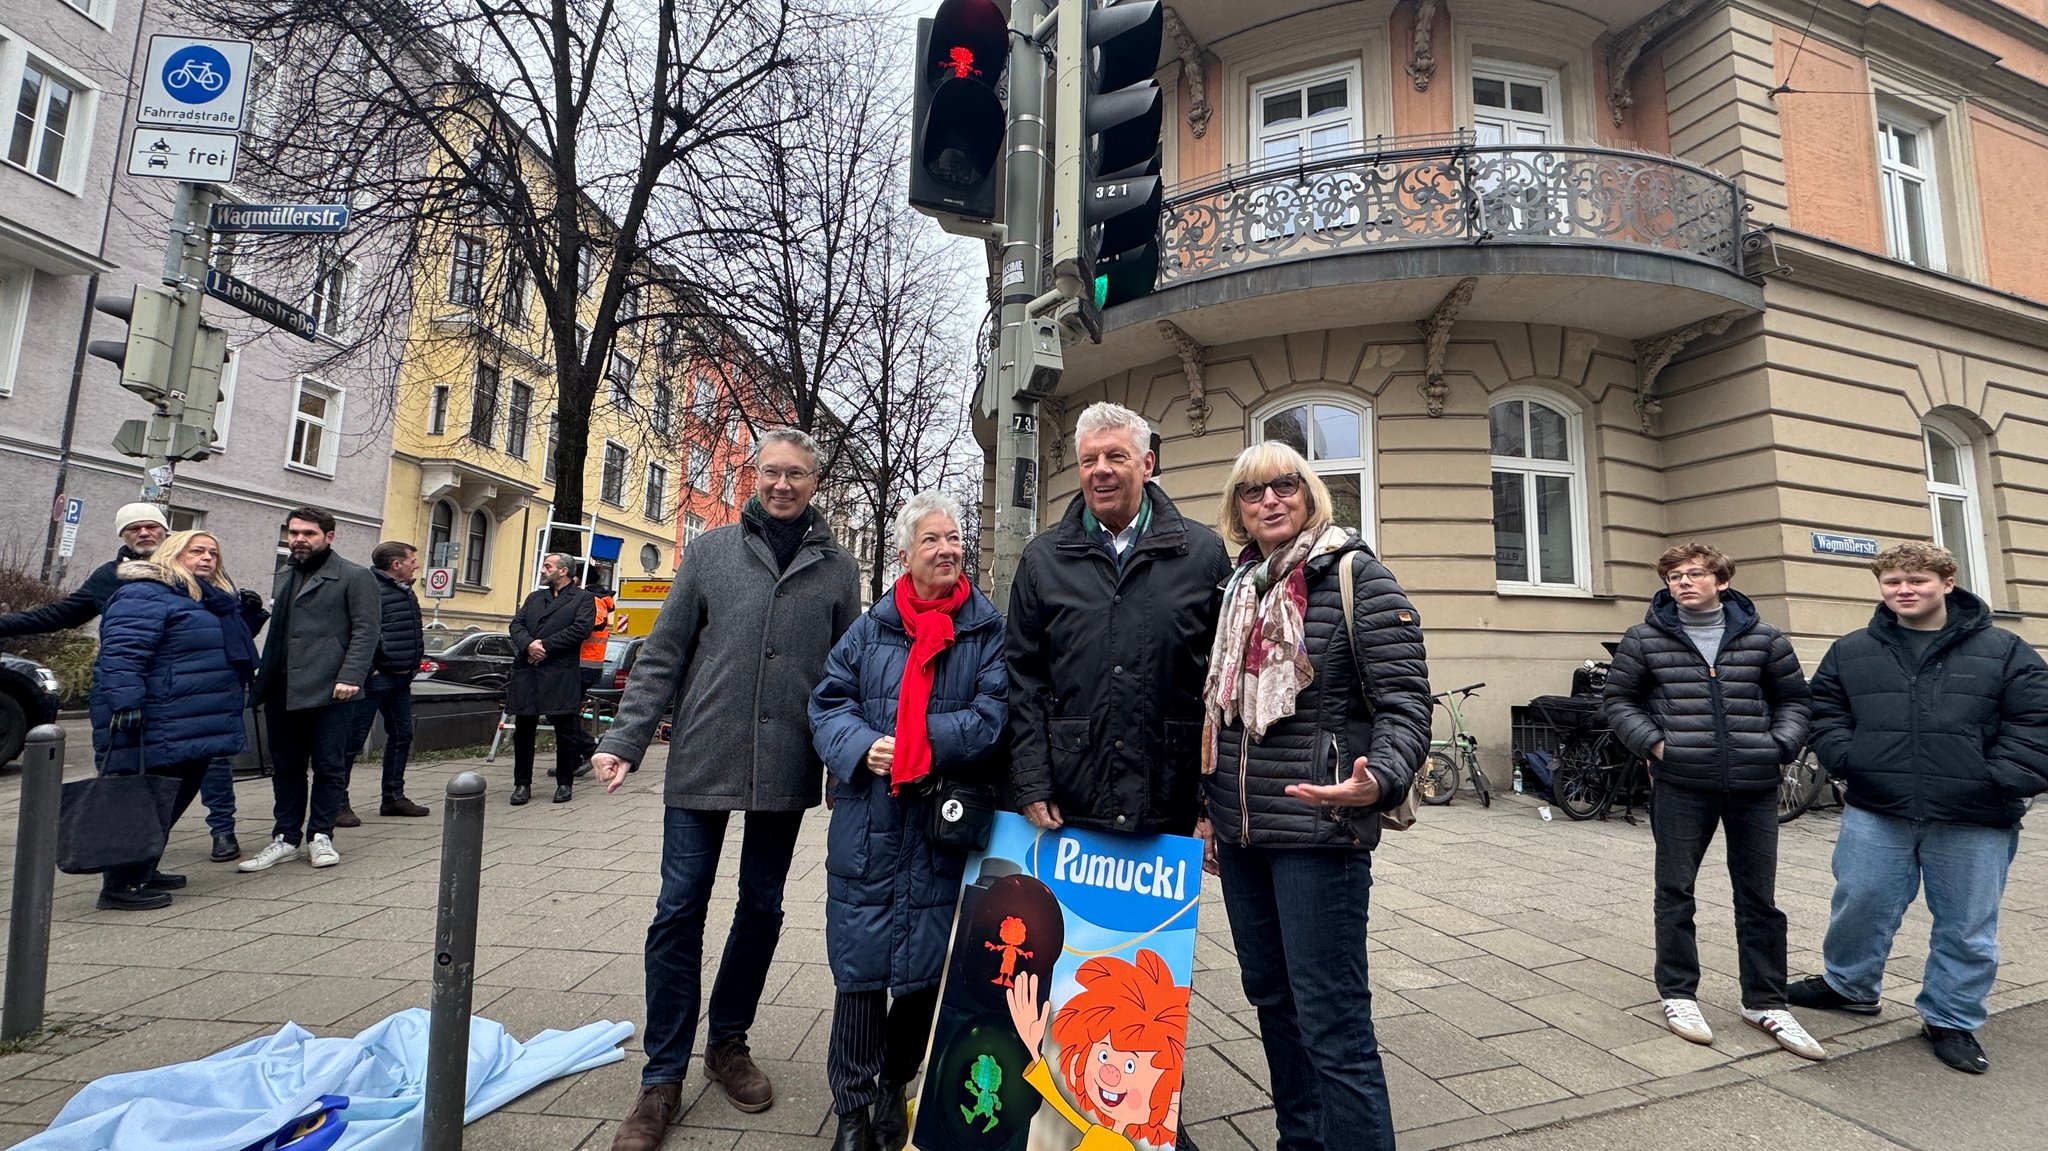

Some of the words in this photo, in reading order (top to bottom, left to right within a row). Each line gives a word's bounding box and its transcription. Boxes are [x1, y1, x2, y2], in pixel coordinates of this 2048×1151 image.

[143, 106, 236, 124] Fahrradstraße
[188, 147, 227, 166] frei
[217, 207, 341, 229] Wagmüllerstr.
[212, 271, 315, 336] Liebigstraße
[67, 501, 79, 521] P
[1817, 535, 1877, 554] Wagmüllerstr.
[434, 574, 445, 585] 30
[1054, 836, 1187, 901] Pumuckl
